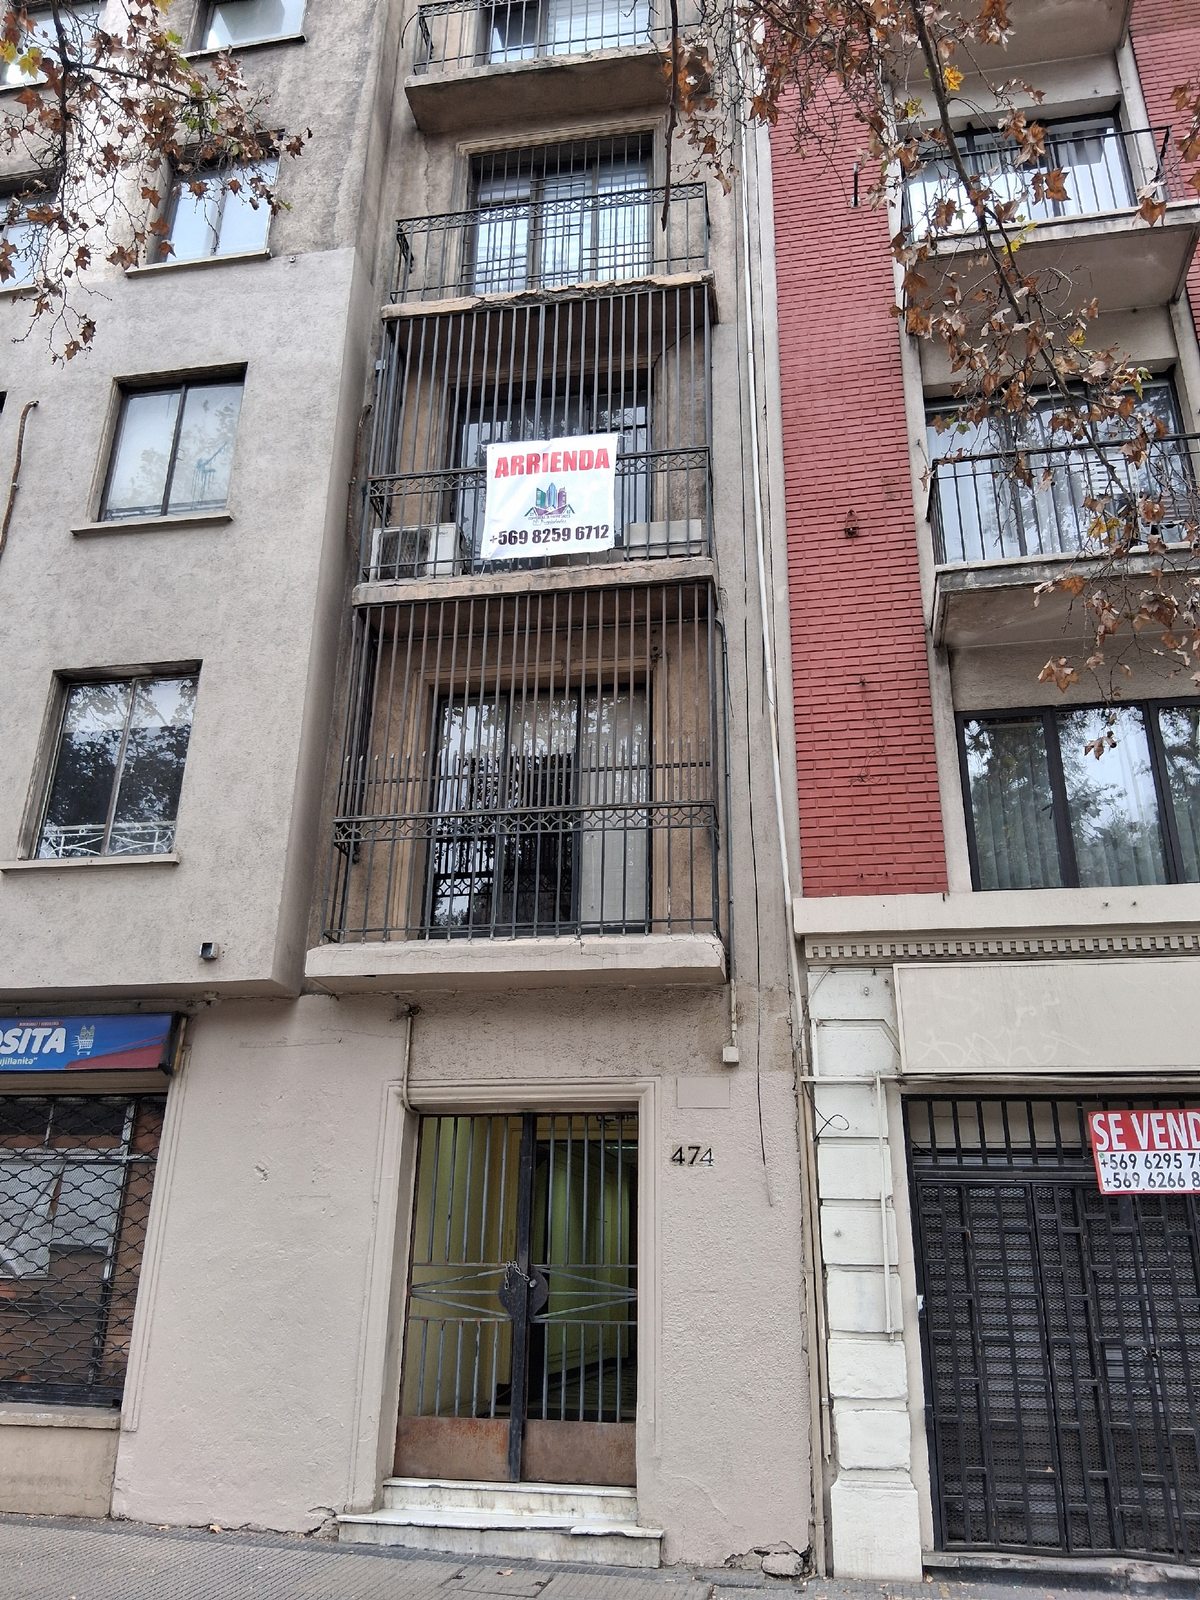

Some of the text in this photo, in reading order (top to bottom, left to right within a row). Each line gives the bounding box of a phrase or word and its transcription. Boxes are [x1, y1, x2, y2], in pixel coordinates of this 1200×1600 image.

[494, 448, 610, 479] ARRIENDA
[489, 524, 610, 546] +569 8259 6712
[0, 1027, 67, 1055] SITA
[1092, 1113, 1127, 1151] SE
[670, 1145, 715, 1166] 474
[1101, 1153, 1200, 1170] +569 6295 7
[1104, 1172, 1140, 1189] +569
[1147, 1171, 1186, 1189] 6266
